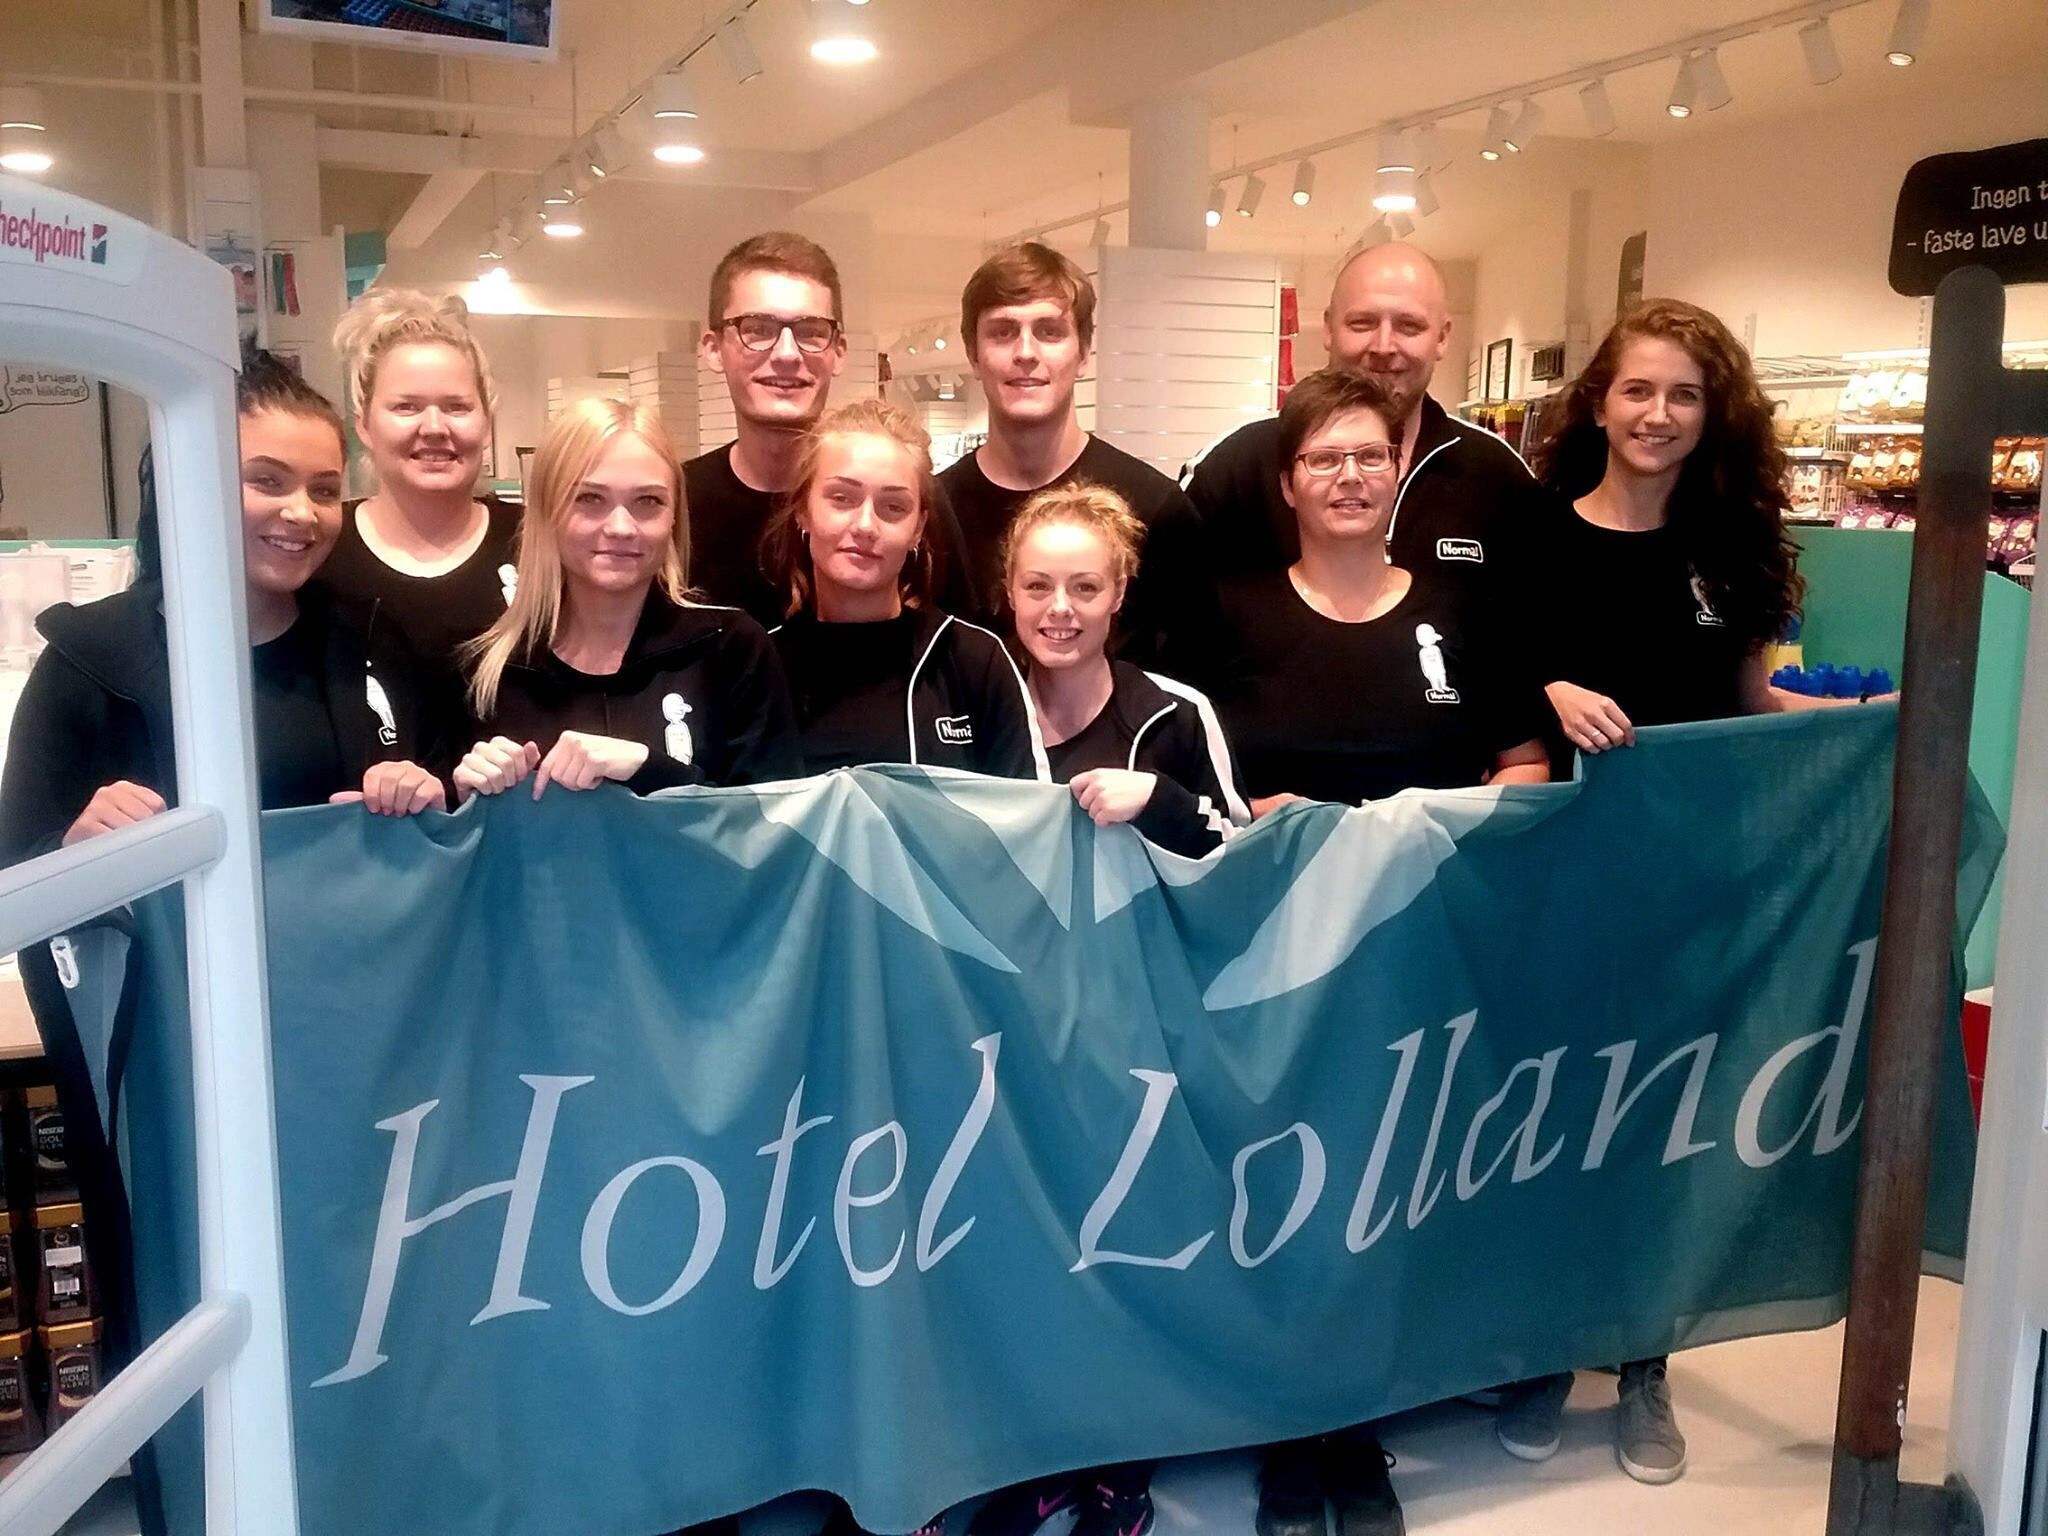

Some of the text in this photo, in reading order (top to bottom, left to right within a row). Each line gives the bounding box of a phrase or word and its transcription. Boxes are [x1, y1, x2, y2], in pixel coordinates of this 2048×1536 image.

[1970, 185, 2031, 210] Ingen
[1923, 229, 1975, 254] faste
[1981, 223, 2027, 249] lave
[1442, 541, 1479, 557] Normal
[310, 935, 1879, 1388] Hotel Lolland
